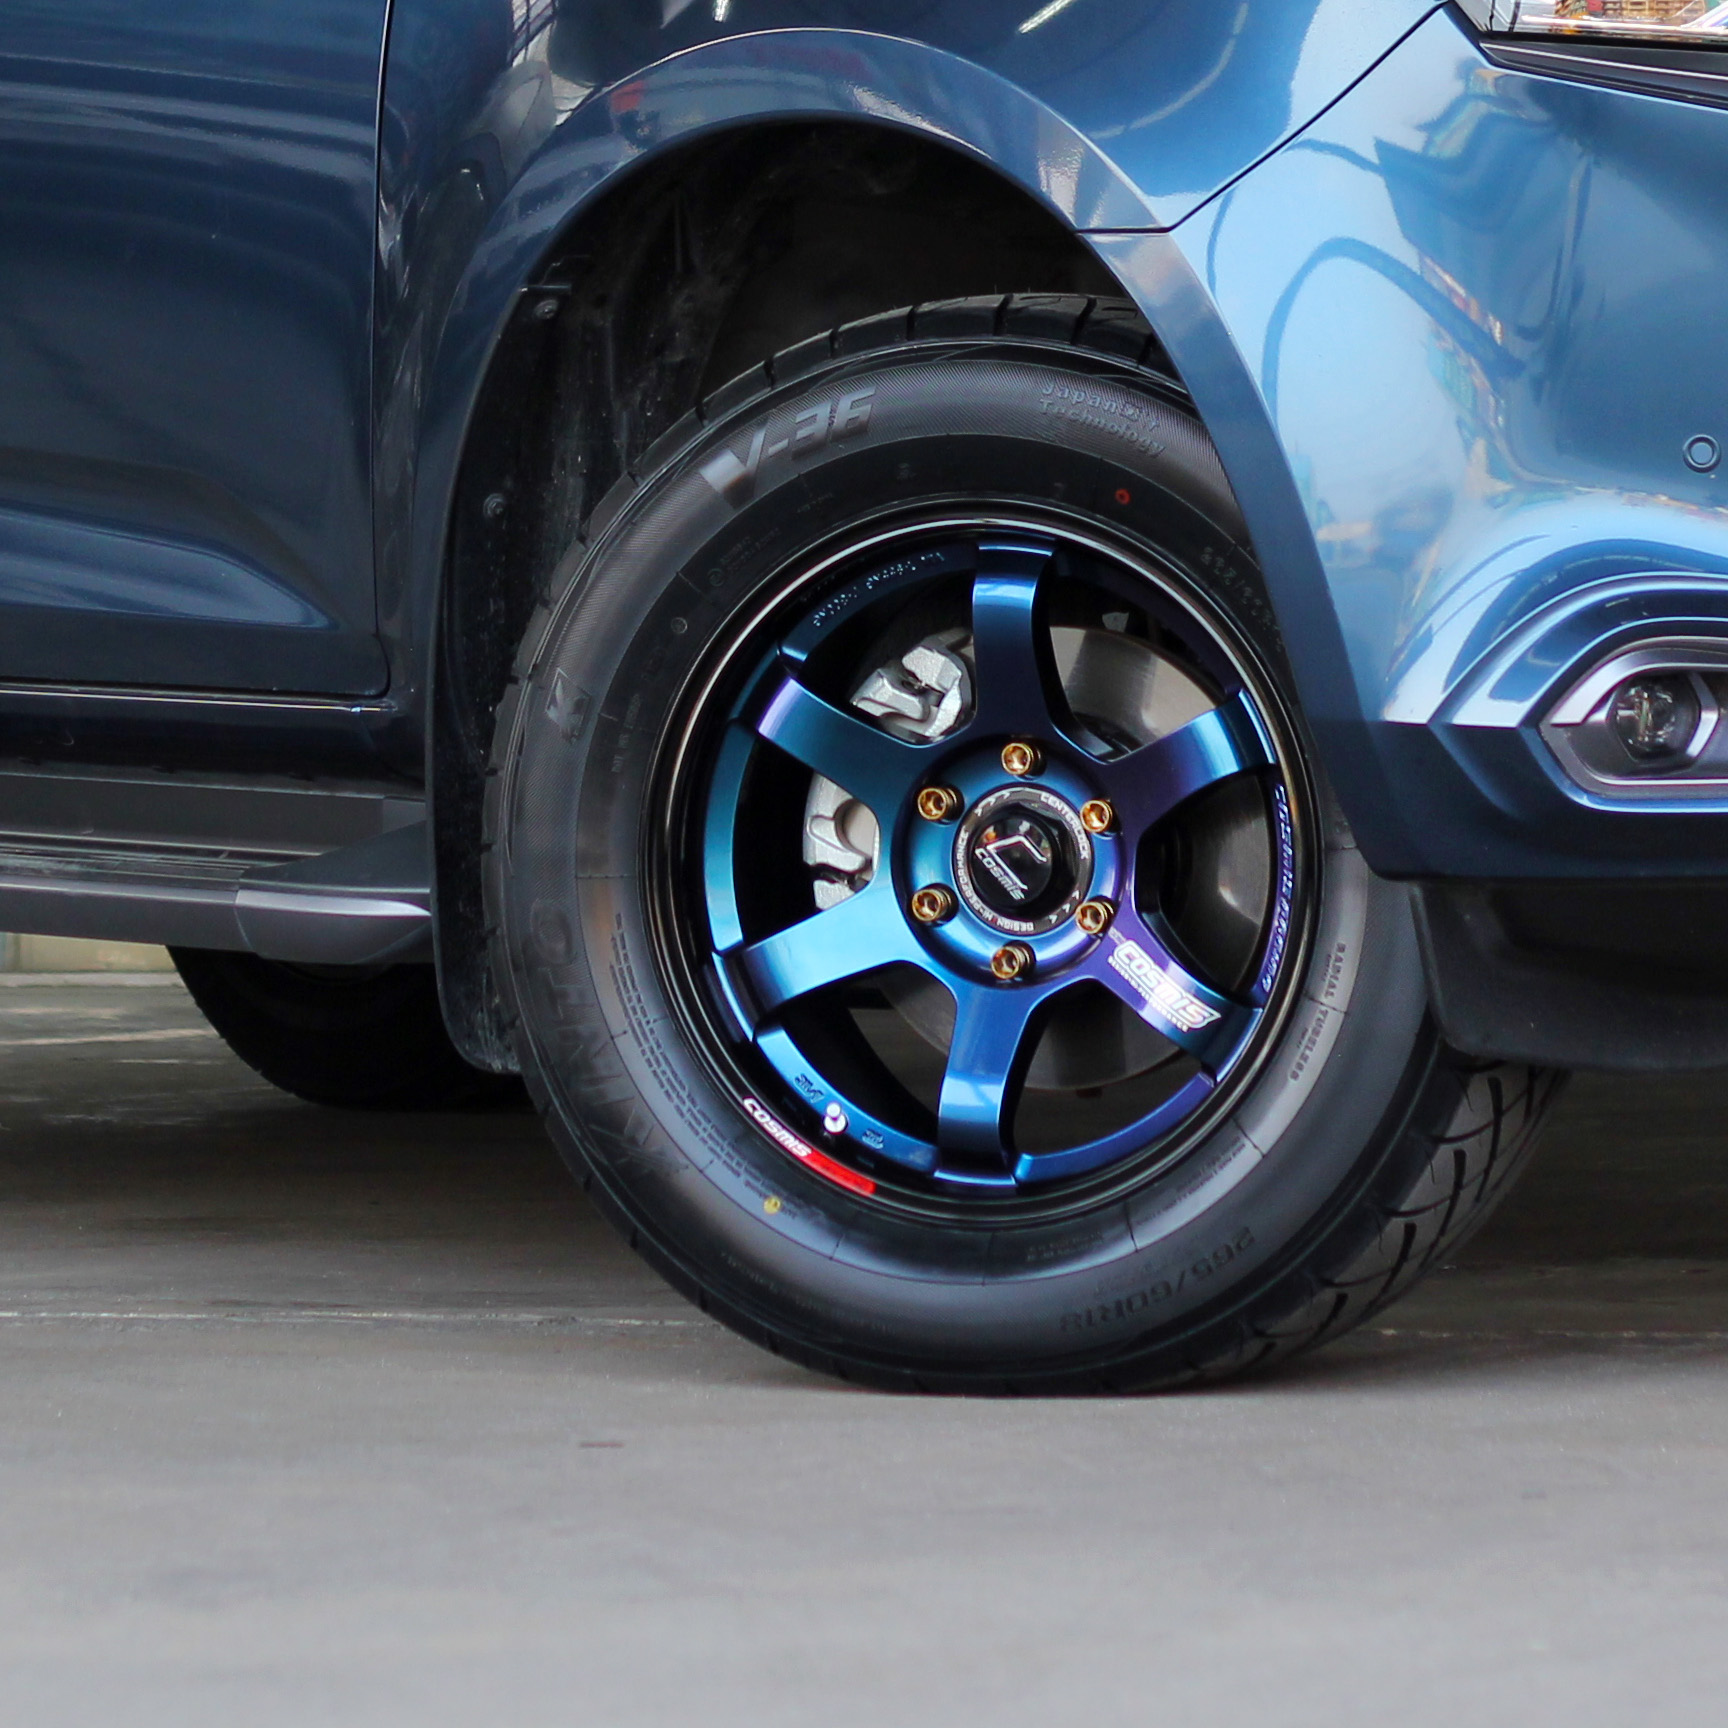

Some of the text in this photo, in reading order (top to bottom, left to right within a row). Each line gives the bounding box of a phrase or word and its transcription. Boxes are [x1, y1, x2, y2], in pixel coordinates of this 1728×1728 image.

[1041, 380, 1118, 414] Japan
[1039, 398, 1166, 458] Technology
[1114, 942, 1218, 1027] COSMIS
[743, 1097, 813, 1157] COSMIS
